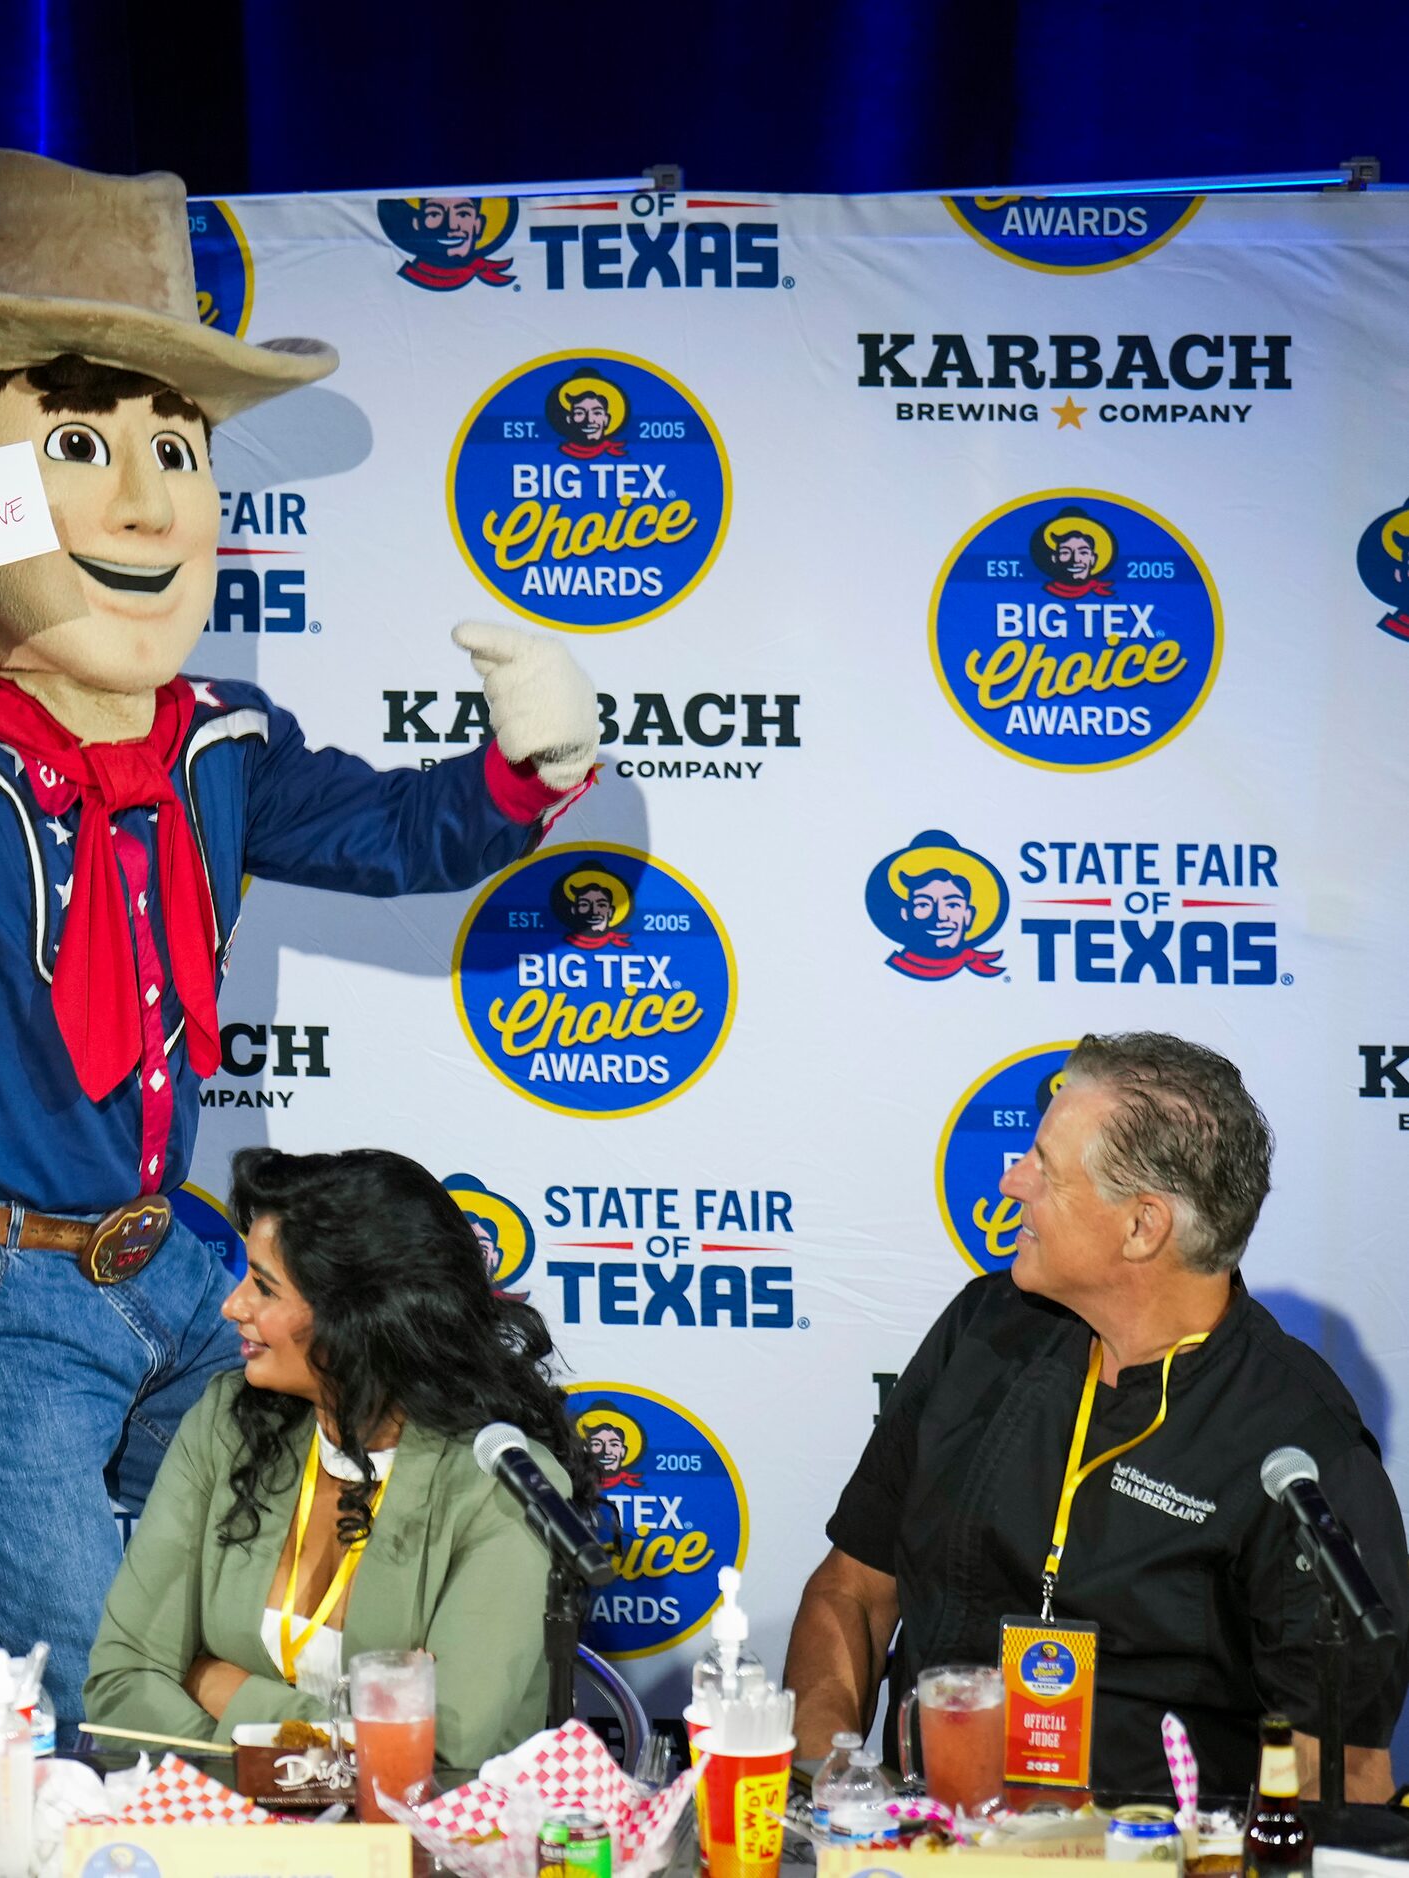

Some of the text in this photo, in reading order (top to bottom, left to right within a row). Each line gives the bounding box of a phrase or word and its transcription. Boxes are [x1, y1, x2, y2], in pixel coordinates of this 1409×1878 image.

[630, 194, 676, 218] OF
[1002, 207, 1148, 237] AWARDS
[529, 223, 779, 289] TEXAS
[857, 333, 1292, 389] KARBACH
[896, 403, 1252, 423] BREWING COMPANY
[503, 422, 685, 439] EST. 2005
[512, 464, 667, 499] BIG TEX
[482, 494, 697, 570] Choice
[520, 566, 663, 596] AWARDS
[986, 561, 1175, 578] EST. 2005
[997, 603, 1155, 639] BIG TEX
[964, 633, 1188, 709] Choice
[383, 690, 801, 747] KAACH
[1005, 705, 1151, 736] AWARDS
[615, 760, 763, 779] COMPANY
[1020, 841, 1279, 887] STATE FAIR
[1125, 891, 1170, 914] OF
[508, 912, 690, 932] EST. 2005
[1021, 919, 1277, 985] TEXAS
[518, 954, 672, 989] BIG TEX
[489, 984, 703, 1058] Choice
[528, 1053, 670, 1084] AWARDS
[199, 1090, 294, 1108] MPANY
[993, 1110, 1030, 1128] EST.
[544, 1185, 793, 1233] STATE FAIR
[646, 1235, 689, 1259] OF
[546, 1262, 794, 1329] TEXAS
[655, 1455, 701, 1471] 2005
[1131, 1469, 1166, 1494] Richard
[606, 1495, 682, 1530] TEX
[590, 1596, 680, 1625] ARDS
[1024, 1712, 1066, 1731] OFFICIAL
[1028, 1732, 1060, 1748] JUDGE
[1026, 1761, 1060, 1772] 2023
[744, 1785, 762, 1854] HOWDY
